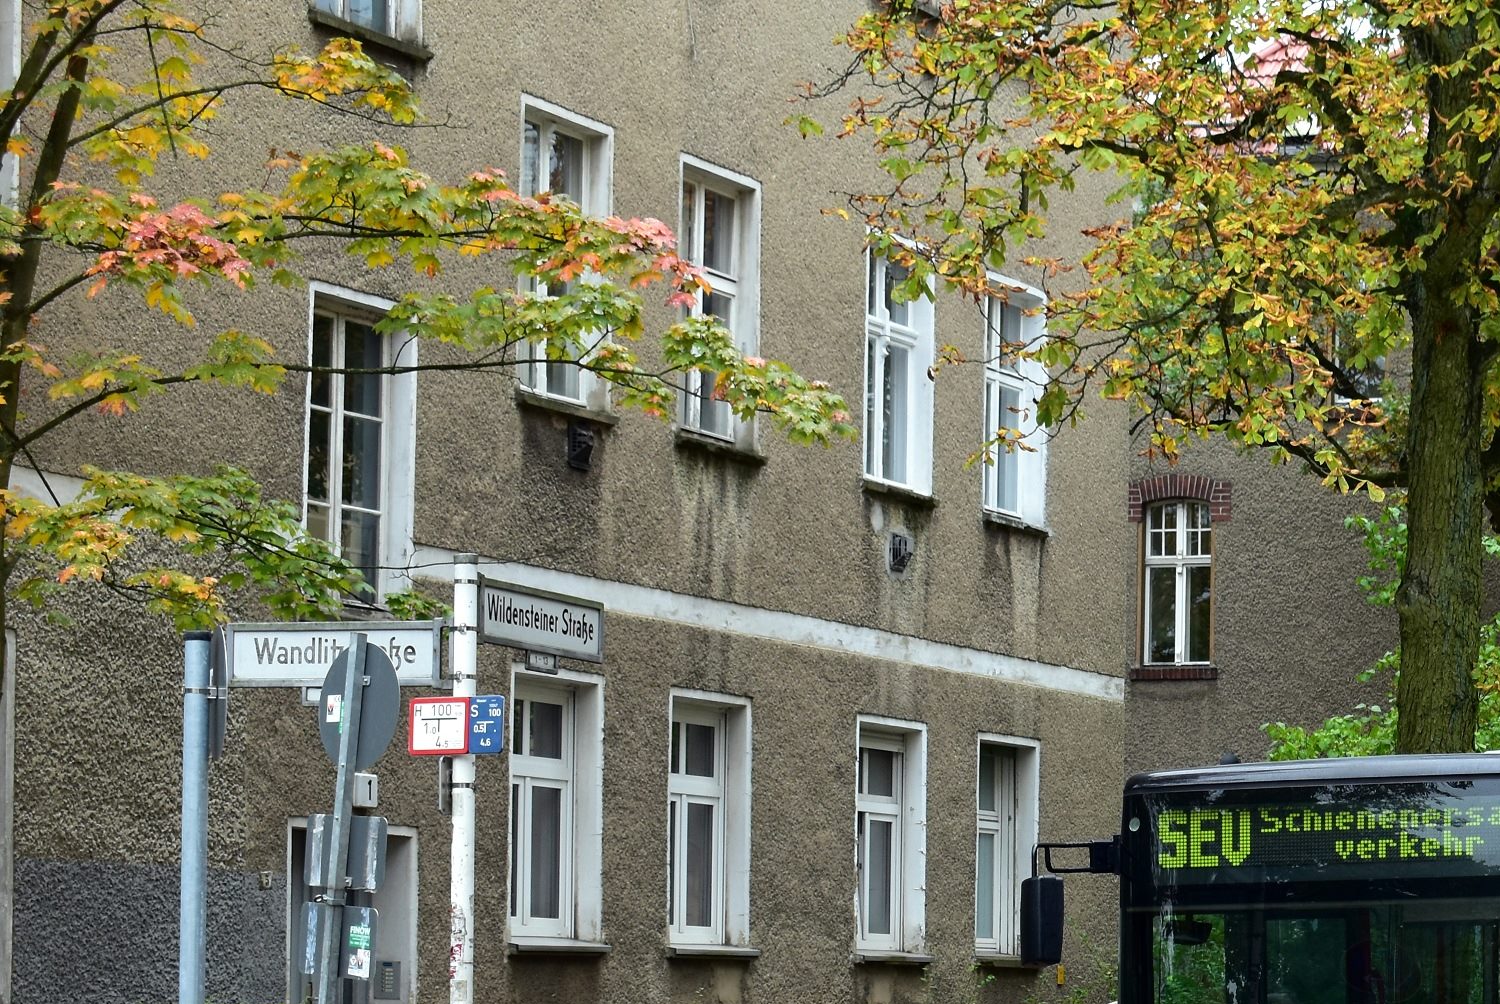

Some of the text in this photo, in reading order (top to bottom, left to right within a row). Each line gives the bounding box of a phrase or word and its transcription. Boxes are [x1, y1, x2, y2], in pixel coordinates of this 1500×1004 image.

[487, 592, 594, 645] Wildensteiner Straße
[254, 636, 416, 671] Wandlitße
[415, 705, 422, 717] H
[432, 704, 452, 717] 100
[470, 704, 479, 717] S
[488, 708, 501, 717] 100
[367, 779, 372, 801] 1
[1158, 810, 1251, 868] SEV
[1335, 830, 1485, 859] verkehr
